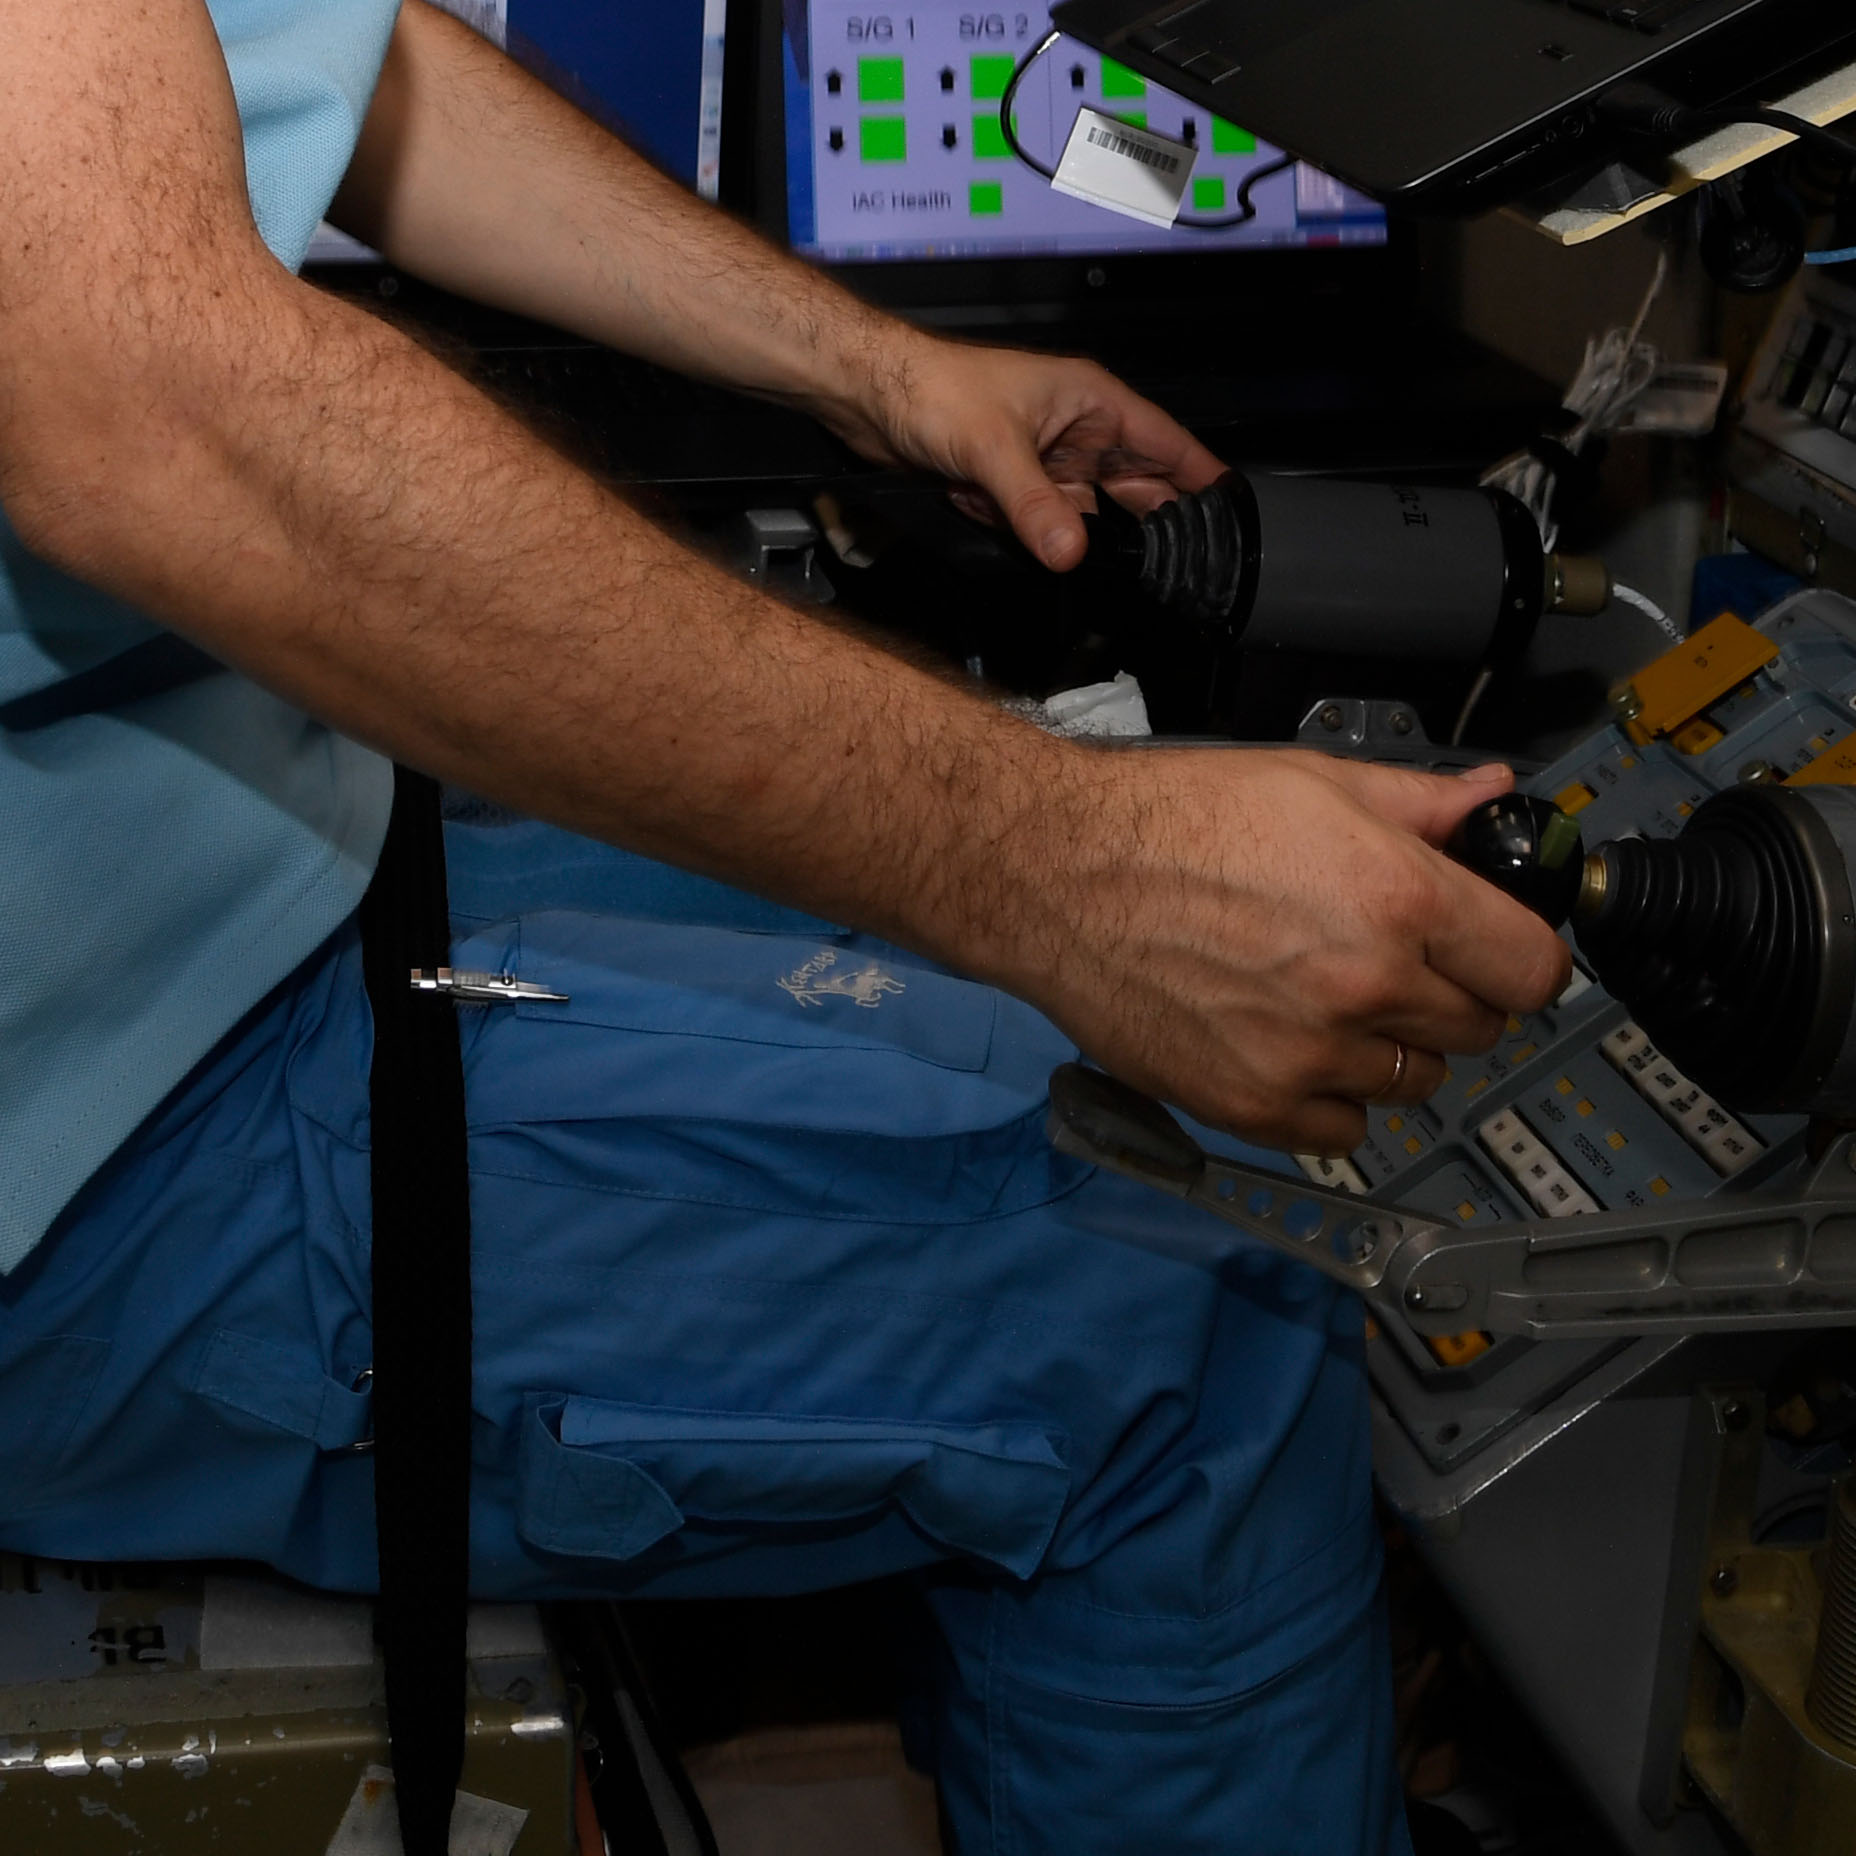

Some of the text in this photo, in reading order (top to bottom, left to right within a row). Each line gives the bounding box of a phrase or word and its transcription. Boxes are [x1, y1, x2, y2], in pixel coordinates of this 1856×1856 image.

[847, 17, 916, 40] S/G 1
[959, 15, 1030, 39] S/G 2
[891, 189, 952, 211] Health
